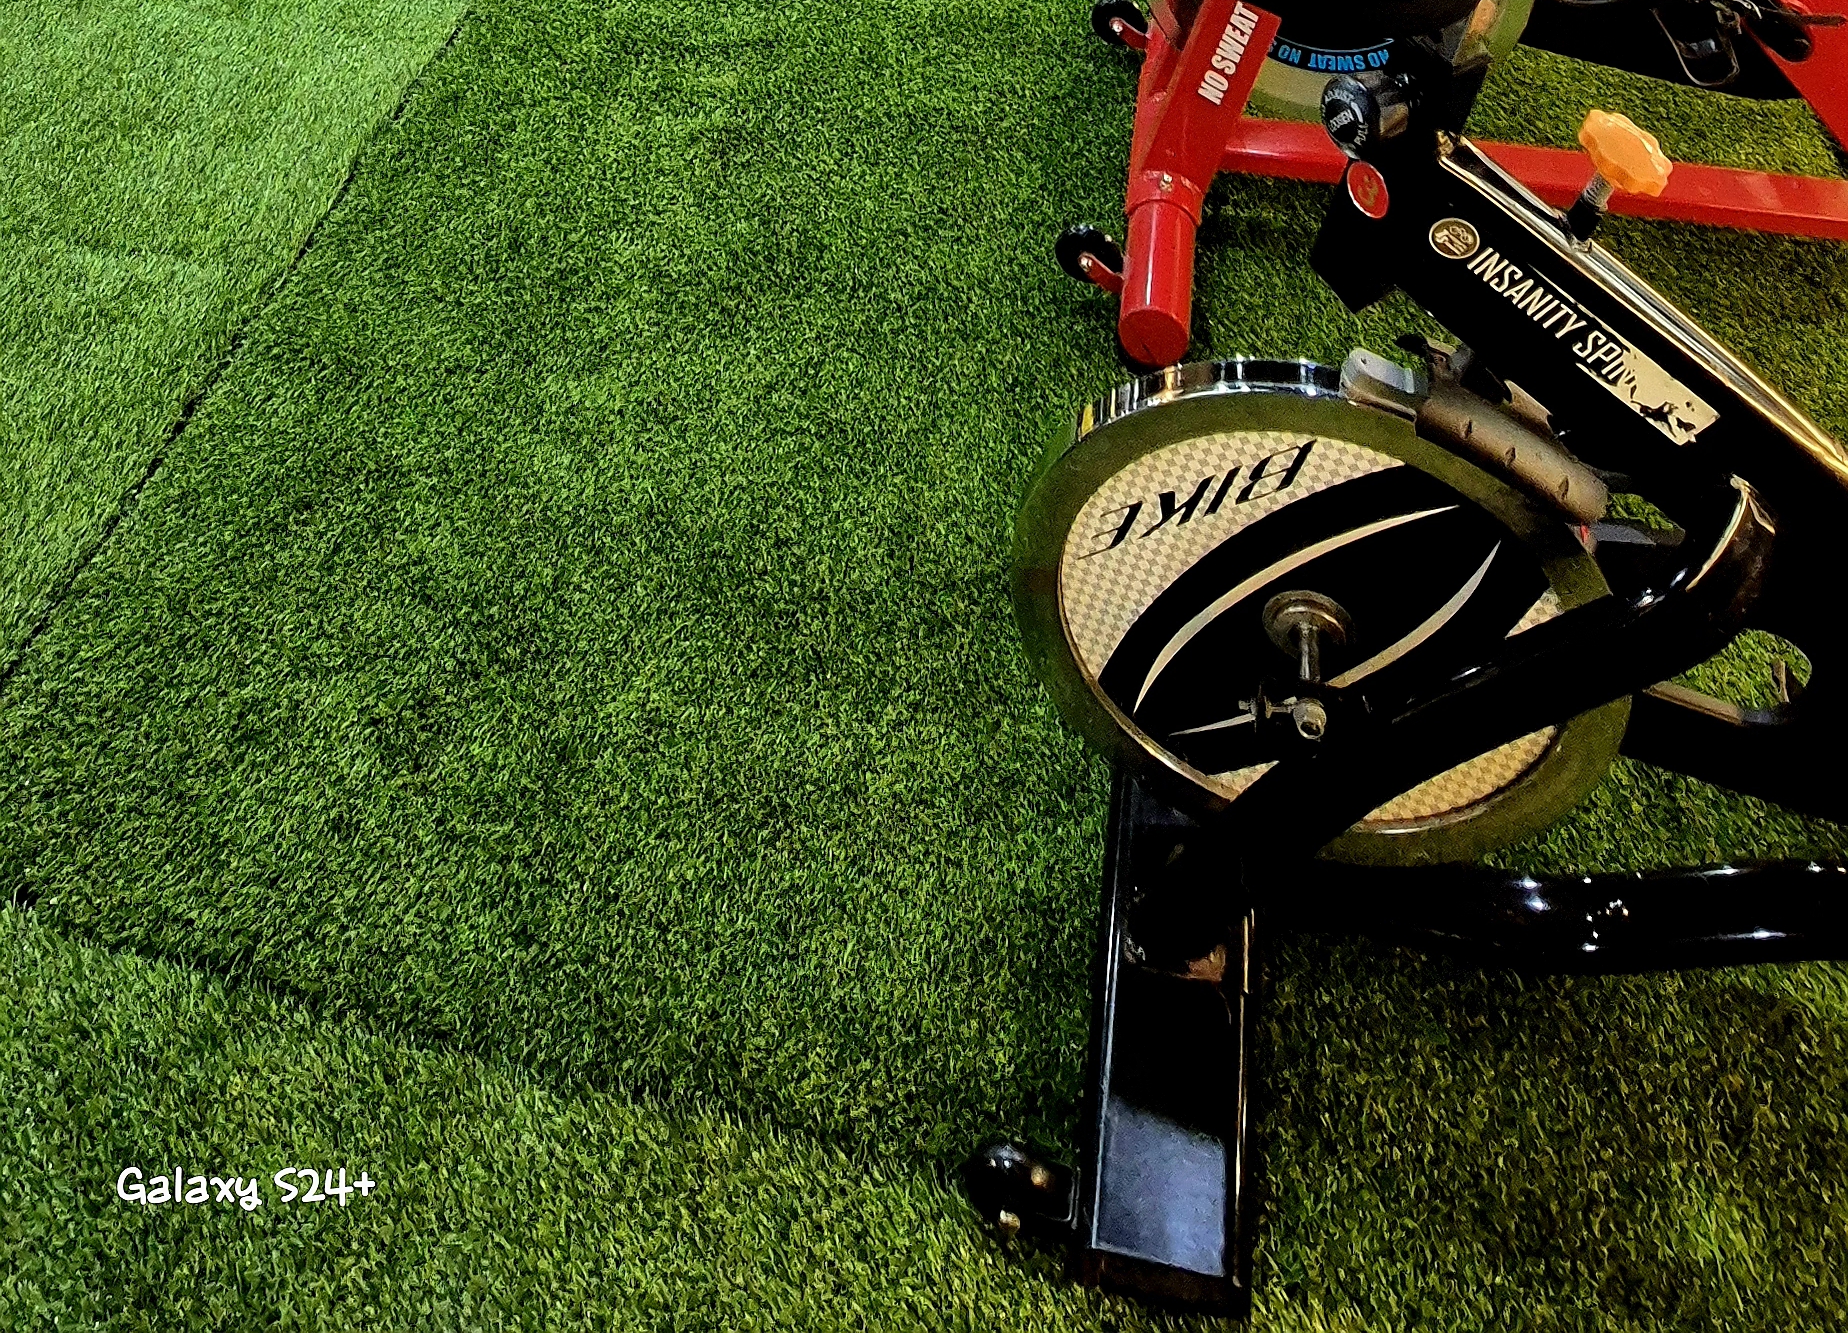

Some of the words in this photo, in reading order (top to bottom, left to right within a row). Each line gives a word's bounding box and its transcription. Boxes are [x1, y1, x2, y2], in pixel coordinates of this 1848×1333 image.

[1211, 0, 1260, 76] SWEAT
[1308, 52, 1366, 71] SWEAT
[1197, 69, 1230, 106] NO
[1466, 246, 1588, 339] INSANITY
[1077, 439, 1317, 560] BIKE
